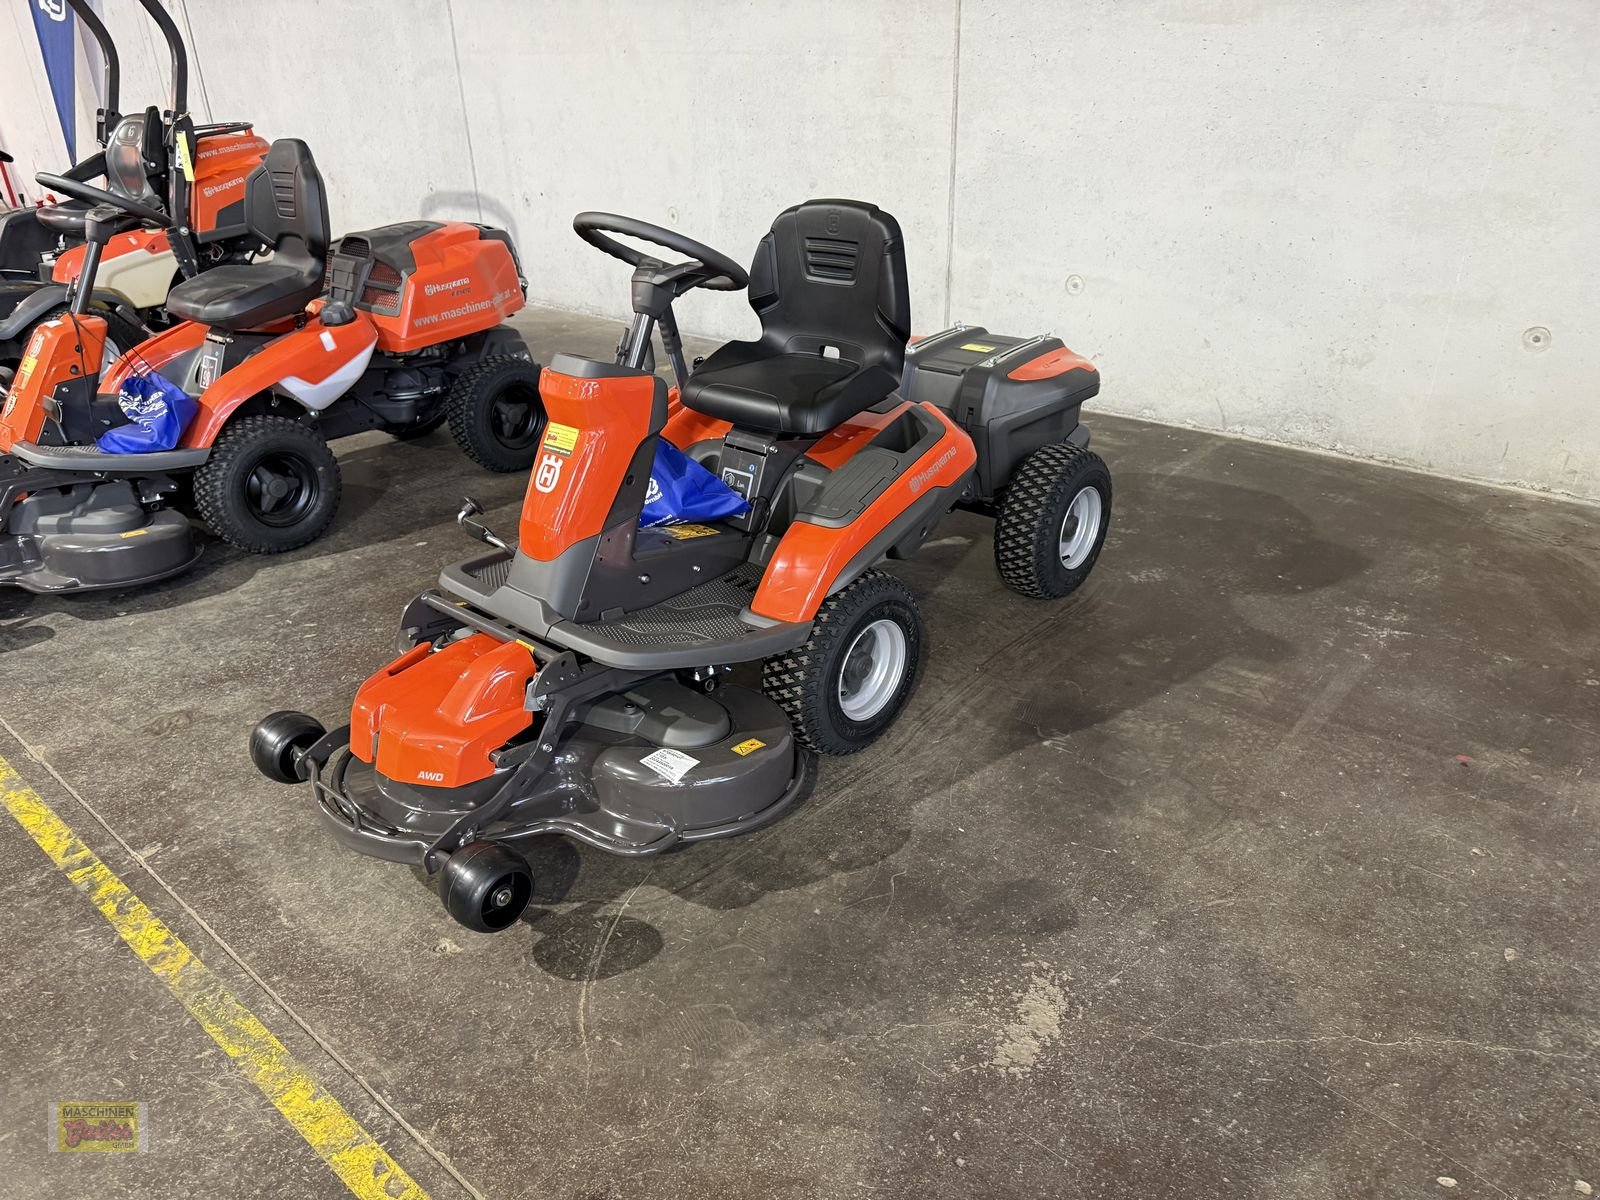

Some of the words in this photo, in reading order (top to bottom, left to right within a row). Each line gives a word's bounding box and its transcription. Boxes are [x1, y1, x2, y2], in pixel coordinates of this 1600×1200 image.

[211, 176, 245, 194] Husqvarna
[433, 277, 470, 294] Husqvarna
[919, 446, 957, 485] Husqvarna
[417, 771, 444, 782] AWD
